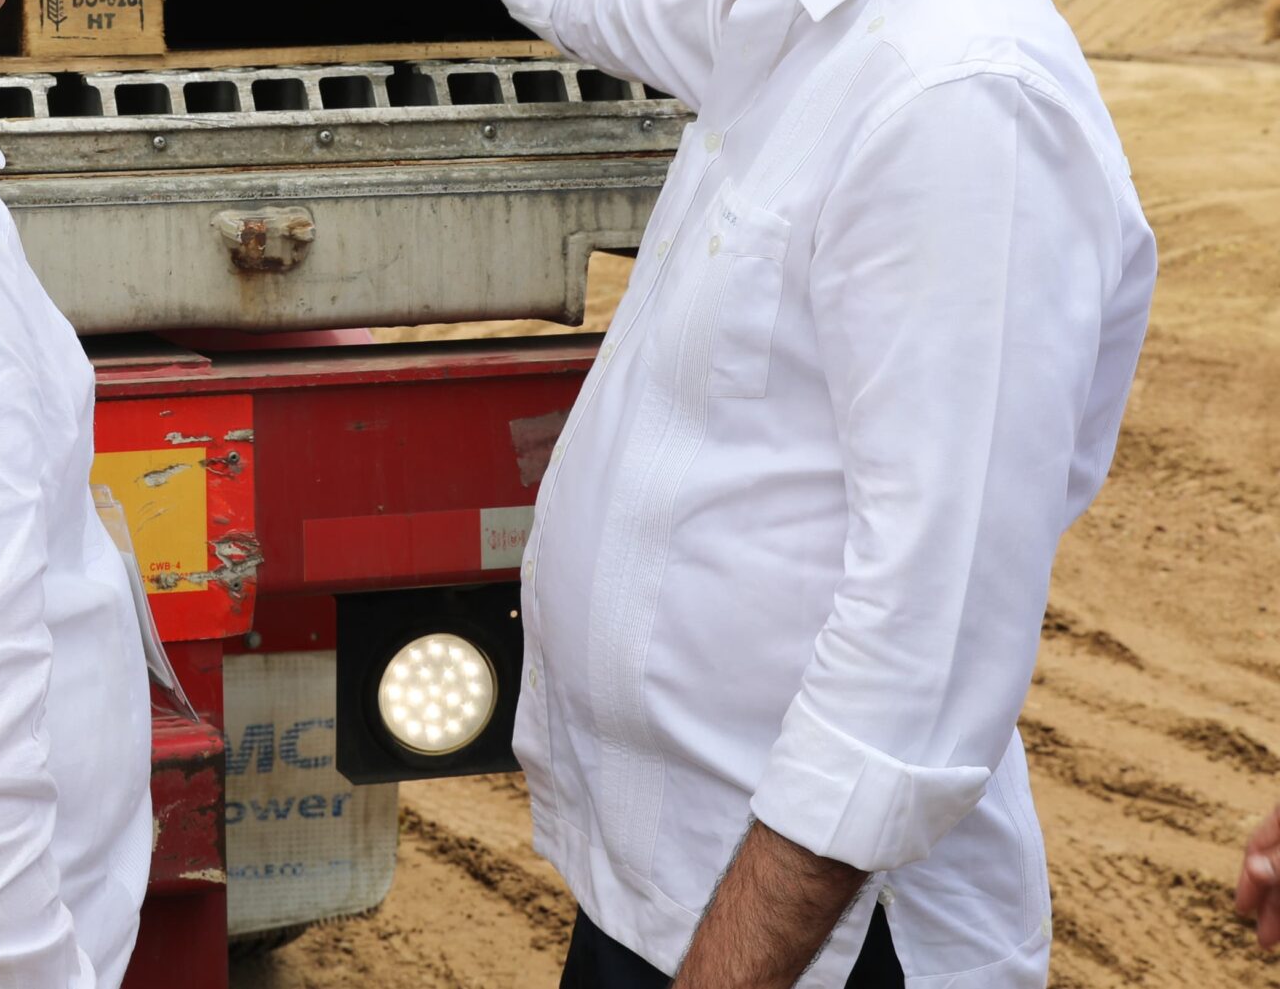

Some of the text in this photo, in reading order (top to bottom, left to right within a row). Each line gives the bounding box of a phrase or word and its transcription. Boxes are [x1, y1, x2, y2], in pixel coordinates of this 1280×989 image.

[87, 13, 116, 30] HT
[224, 718, 334, 776] MC
[225, 791, 352, 825] ower
